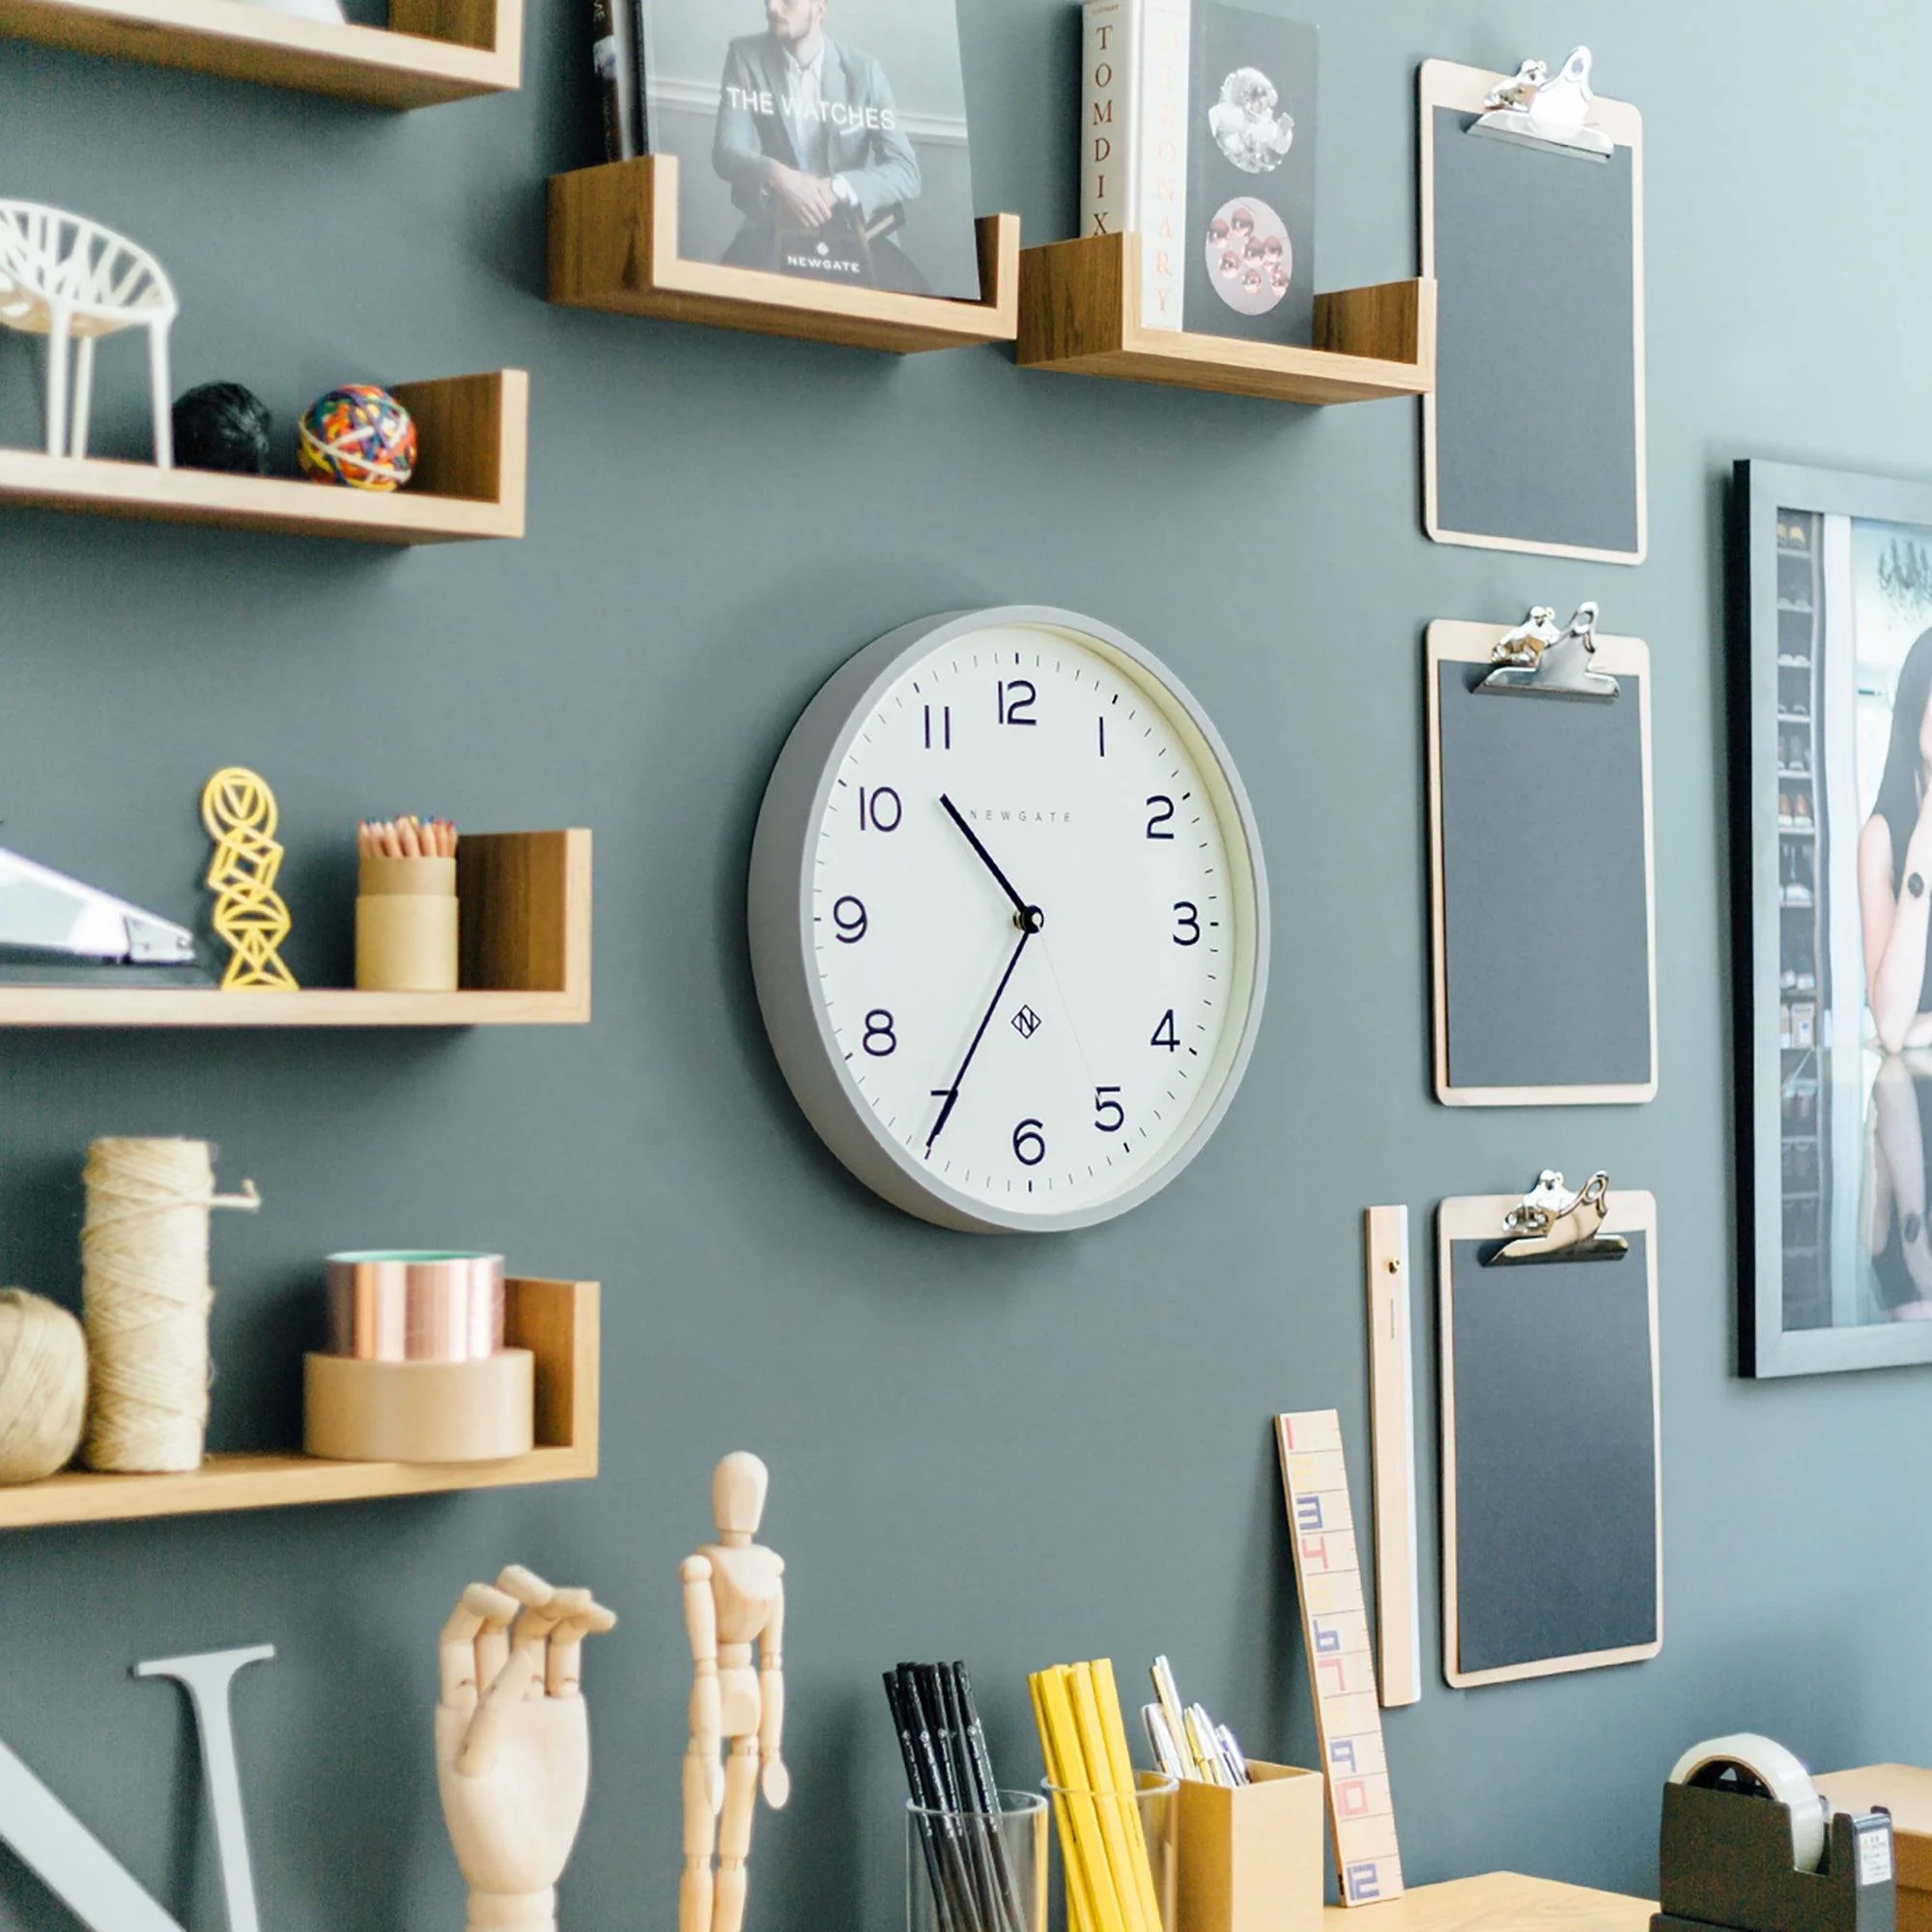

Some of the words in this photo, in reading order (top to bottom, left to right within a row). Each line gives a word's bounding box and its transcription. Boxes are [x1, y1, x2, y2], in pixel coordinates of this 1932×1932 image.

[725, 87, 775, 116] THE
[781, 94, 896, 131] WATCHES
[787, 255, 861, 273] NEWGATE
[997, 679, 1037, 726] 12
[923, 704, 951, 750] 11
[1098, 716, 1105, 757] 1
[859, 786, 902, 833] 10
[969, 810, 1071, 823] NEWGATE
[1146, 795, 1175, 840] 2
[833, 895, 868, 944] 9
[1173, 900, 1201, 947] 3
[862, 1009, 897, 1057] 8
[1150, 1009, 1181, 1053] 4
[1094, 1086, 1124, 1133] 5
[1012, 1118, 1046, 1166] 6
[1295, 1495, 1323, 1531] 3
[1300, 1535, 1329, 1570] 4
[1329, 1739, 1357, 1774] 9
[1347, 1862, 1380, 1901] 12
